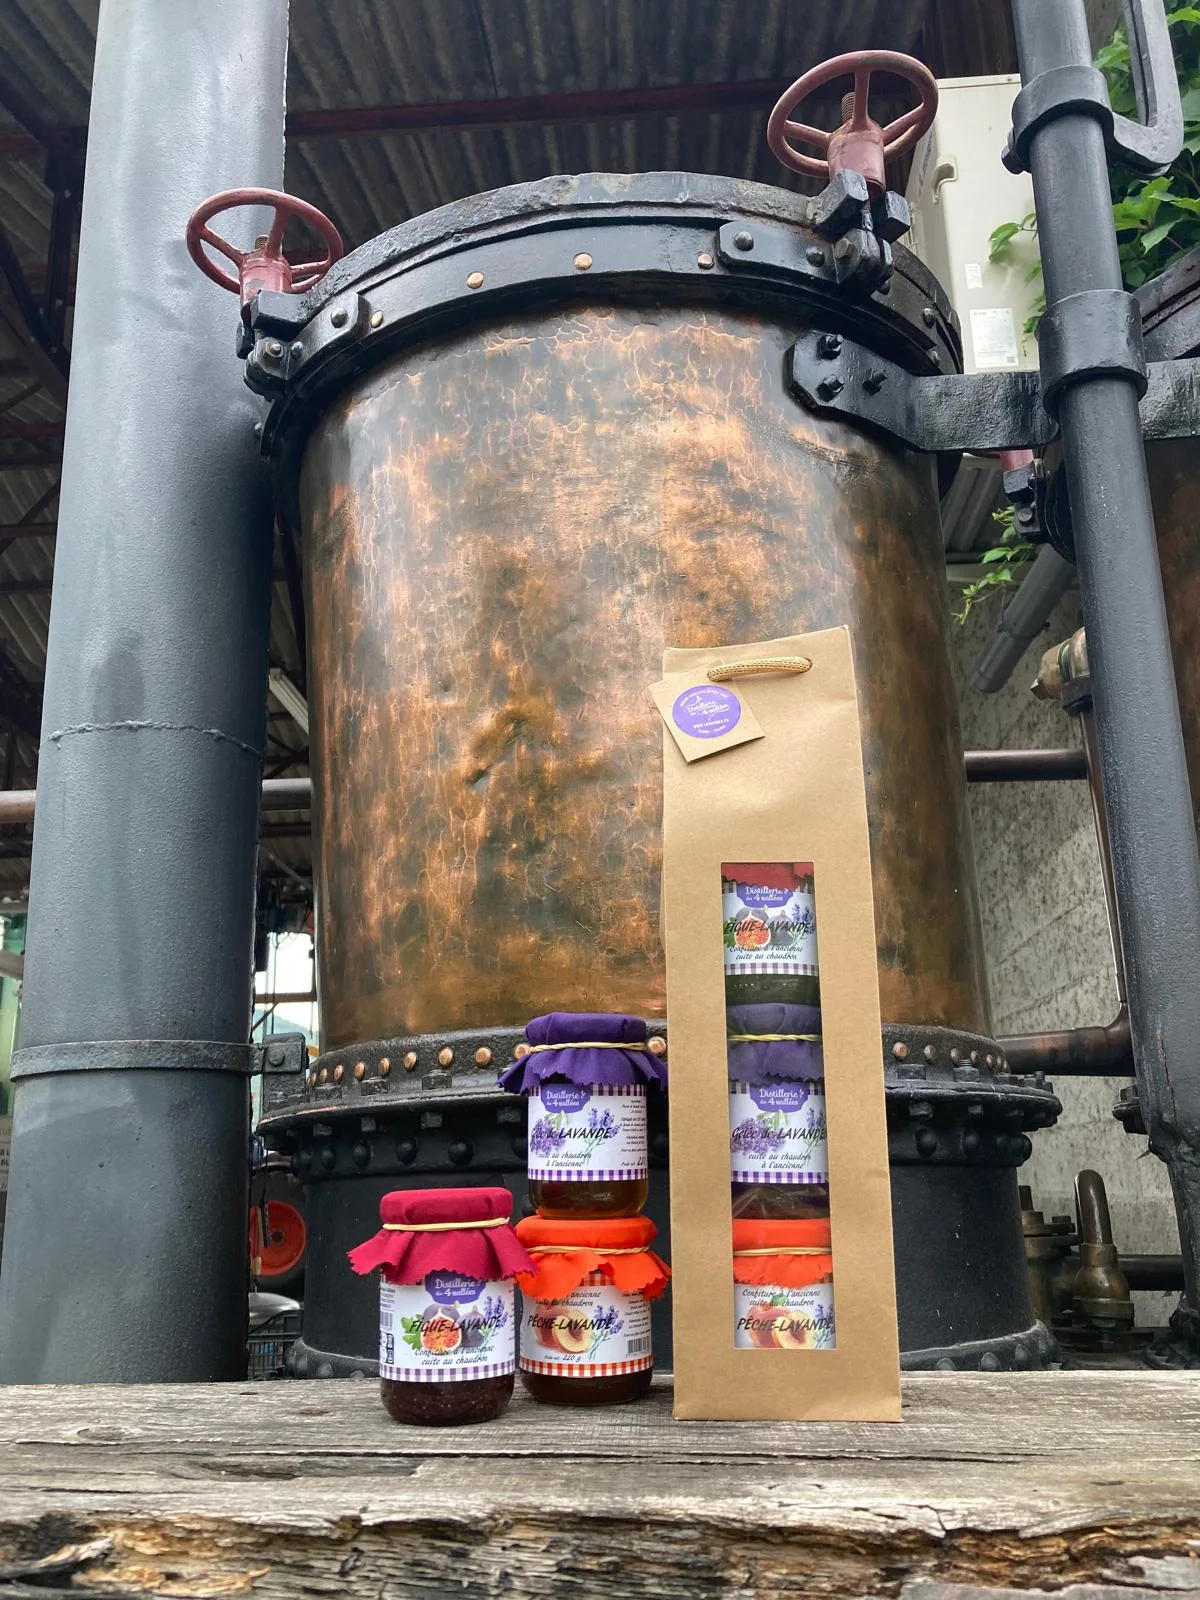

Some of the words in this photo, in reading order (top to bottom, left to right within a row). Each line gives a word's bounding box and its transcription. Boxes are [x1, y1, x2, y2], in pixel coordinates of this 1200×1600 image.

[745, 886, 784, 895] Distillerie
[766, 952, 797, 960] chaudron
[546, 1090, 579, 1100] Distillerie
[760, 1088, 798, 1098] Distillerie
[558, 1099, 580, 1107] vallées
[767, 1097, 775, 1105] 4
[776, 1097, 799, 1105] vallées
[559, 1127, 611, 1139] LAVANDE
[760, 1128, 772, 1139] de
[777, 1127, 827, 1140] LAVANDE
[561, 1151, 592, 1159] chaudron
[748, 1152, 767, 1160] cuite
[545, 1159, 550, 1167] à
[552, 1159, 583, 1167] l'ancienne
[761, 1161, 766, 1169] à
[768, 1161, 805, 1169] l'ancienne
[435, 1278, 476, 1289] Distillerie
[443, 1289, 451, 1297] 4
[452, 1287, 476, 1296] vallées
[742, 1288, 777, 1299] Confiture
[786, 1289, 821, 1298] l'ancienne
[561, 1298, 593, 1307] chaudron
[749, 1299, 767, 1307] cuite
[781, 1298, 814, 1307] chaudron
[527, 1313, 614, 1330] PÊCHE-LAVANDE
[737, 1315, 832, 1332] PÊCHE-LAVANDE
[421, 1356, 441, 1365] cuite
[456, 1354, 488, 1364] chaudron
